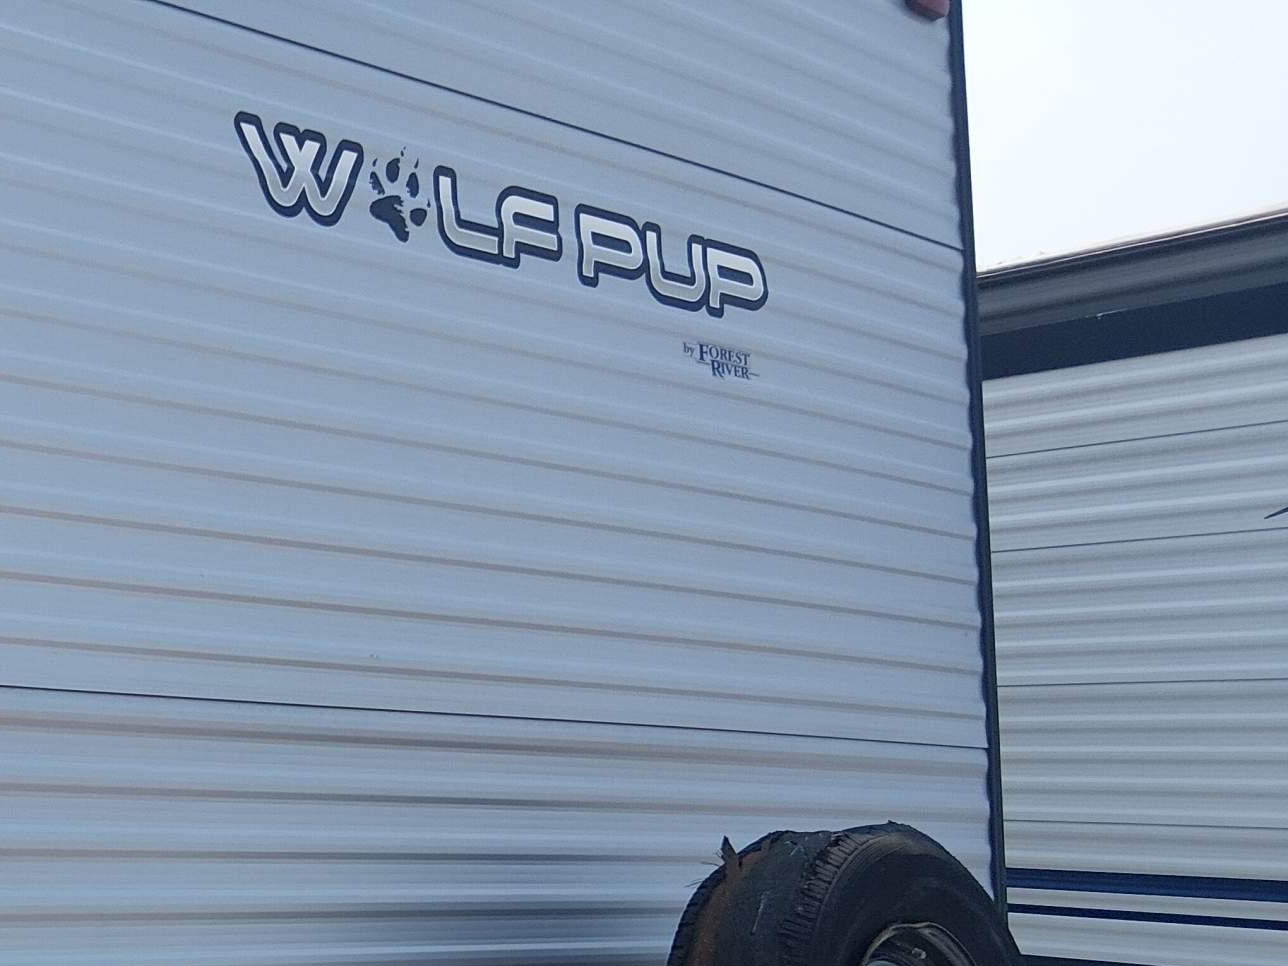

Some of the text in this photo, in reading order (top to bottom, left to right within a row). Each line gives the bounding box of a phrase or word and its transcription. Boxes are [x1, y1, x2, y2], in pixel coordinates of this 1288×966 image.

[234, 111, 769, 318] WLF PUP
[683, 342, 751, 366] by FOREST
[711, 360, 751, 381] RIVER
